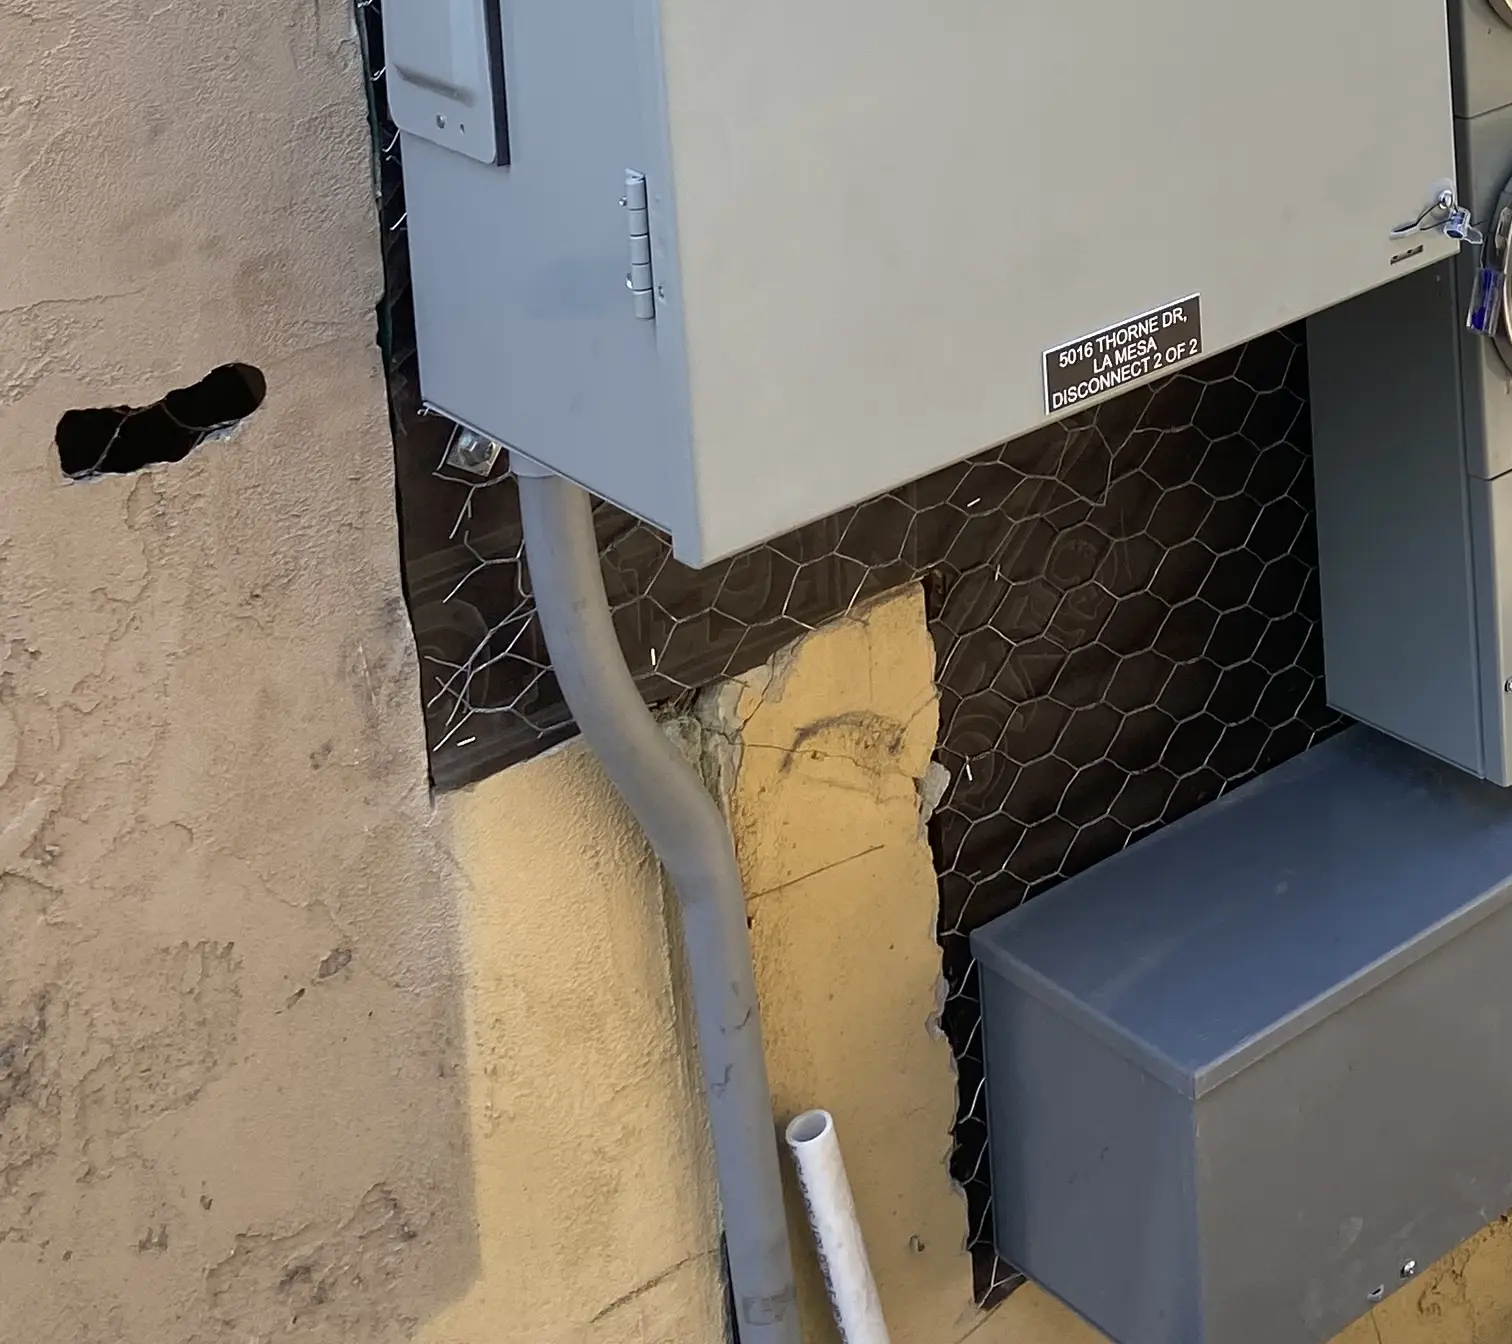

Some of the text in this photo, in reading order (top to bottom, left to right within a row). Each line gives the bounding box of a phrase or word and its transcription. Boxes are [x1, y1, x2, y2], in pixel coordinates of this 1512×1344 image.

[1059, 341, 1094, 368] 5016
[1095, 316, 1159, 353] THORNE
[1093, 336, 1158, 374] LA MESA
[1052, 338, 1198, 409] DISCONNECT 2 OF 2
